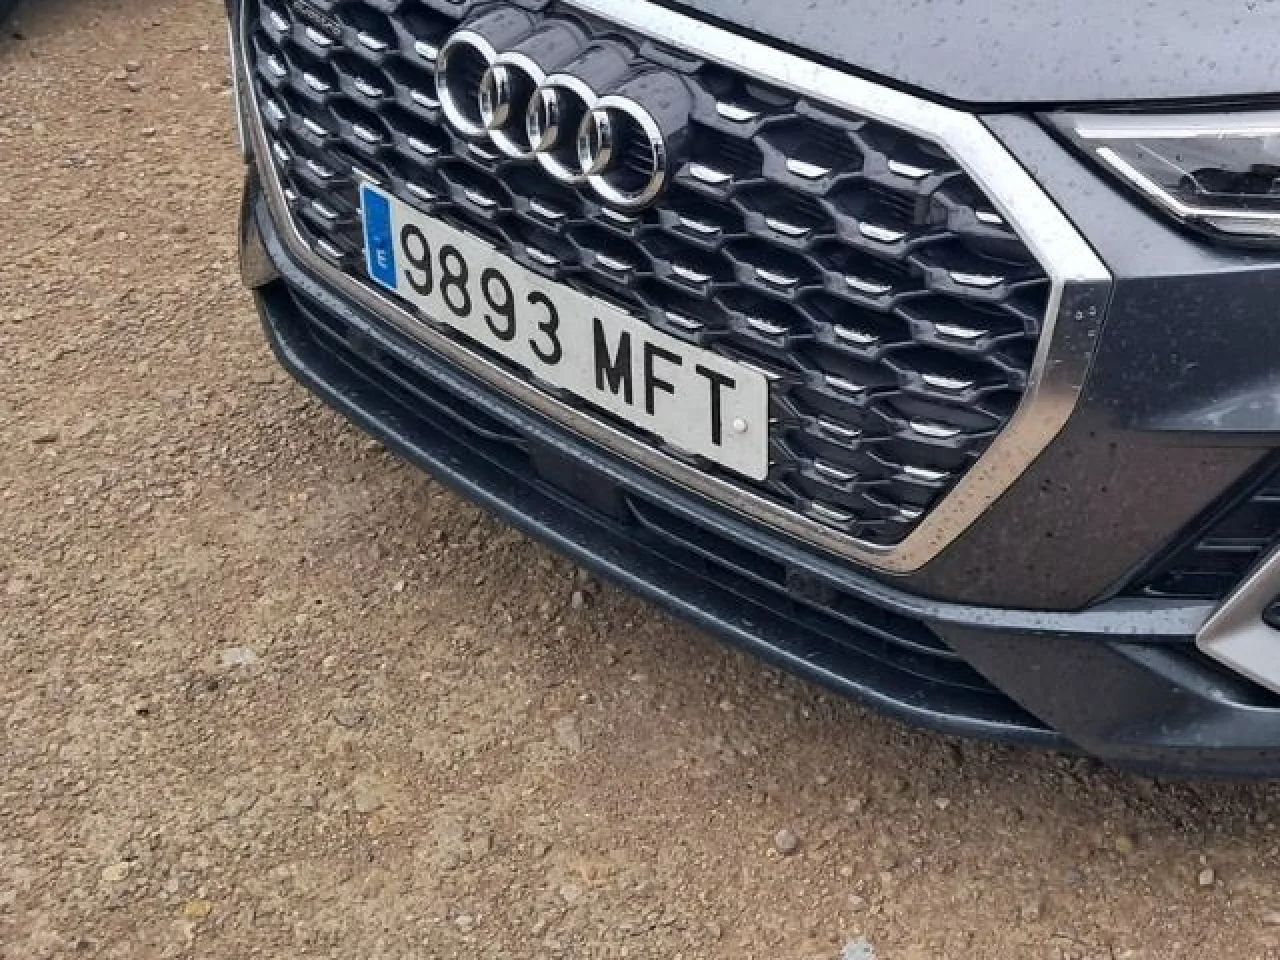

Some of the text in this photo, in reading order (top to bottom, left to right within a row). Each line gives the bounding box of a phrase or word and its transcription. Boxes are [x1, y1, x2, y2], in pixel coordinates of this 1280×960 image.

[376, 248, 388, 270] E
[401, 223, 736, 446] 9893 MFT
